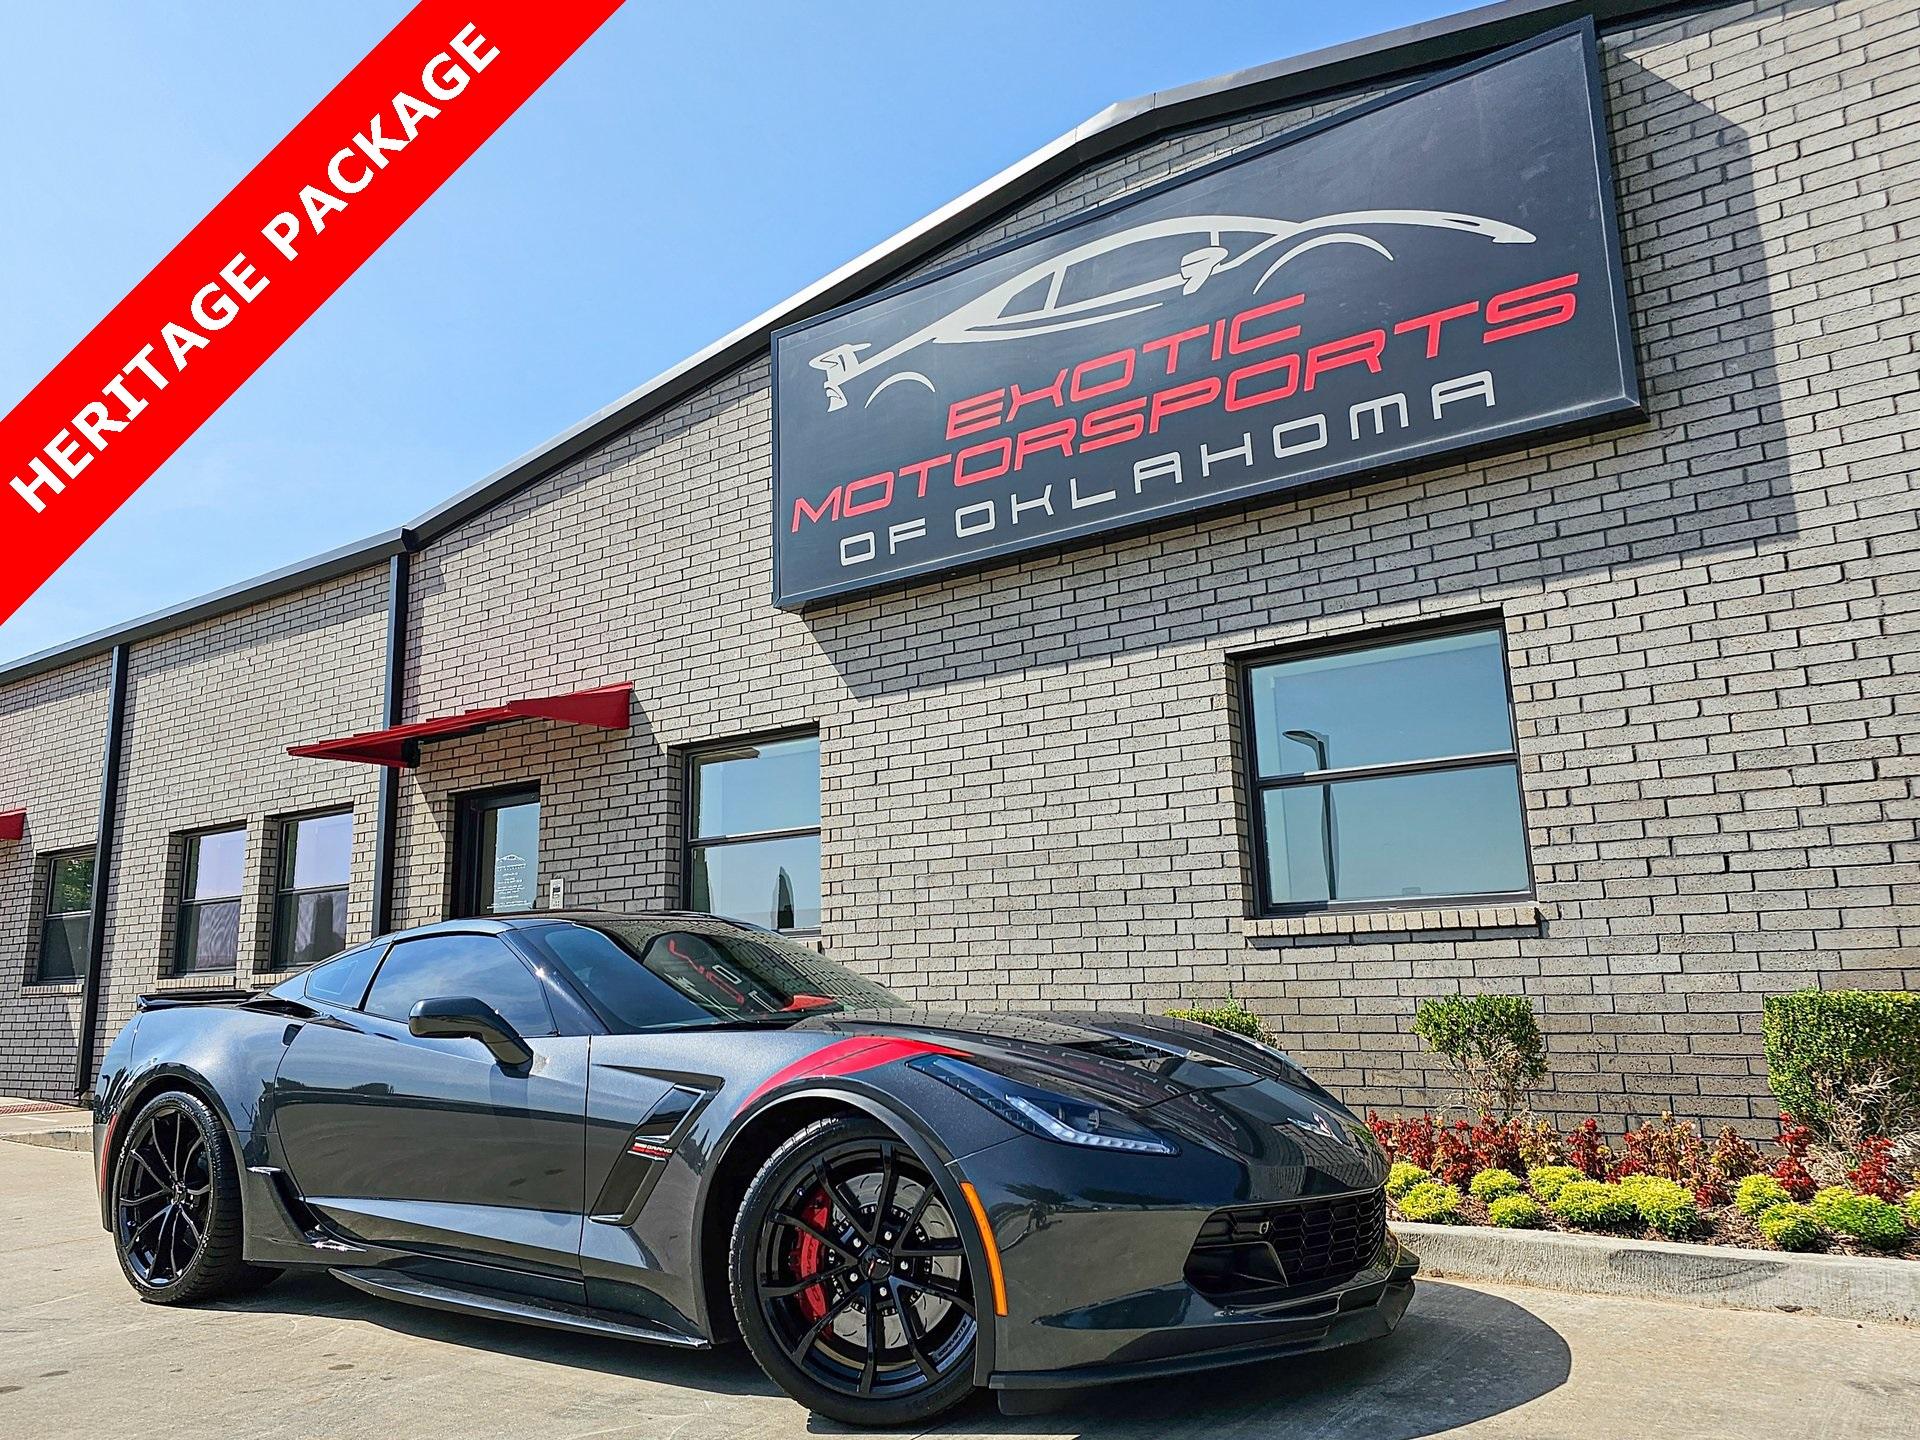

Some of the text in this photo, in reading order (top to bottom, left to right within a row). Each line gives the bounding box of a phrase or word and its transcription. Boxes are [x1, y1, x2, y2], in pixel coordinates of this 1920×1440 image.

[792, 272, 1580, 534] MOTORSPORTS
[945, 294, 1305, 441] EXOTIC
[839, 370, 1496, 567] OF OKLAHOMA
